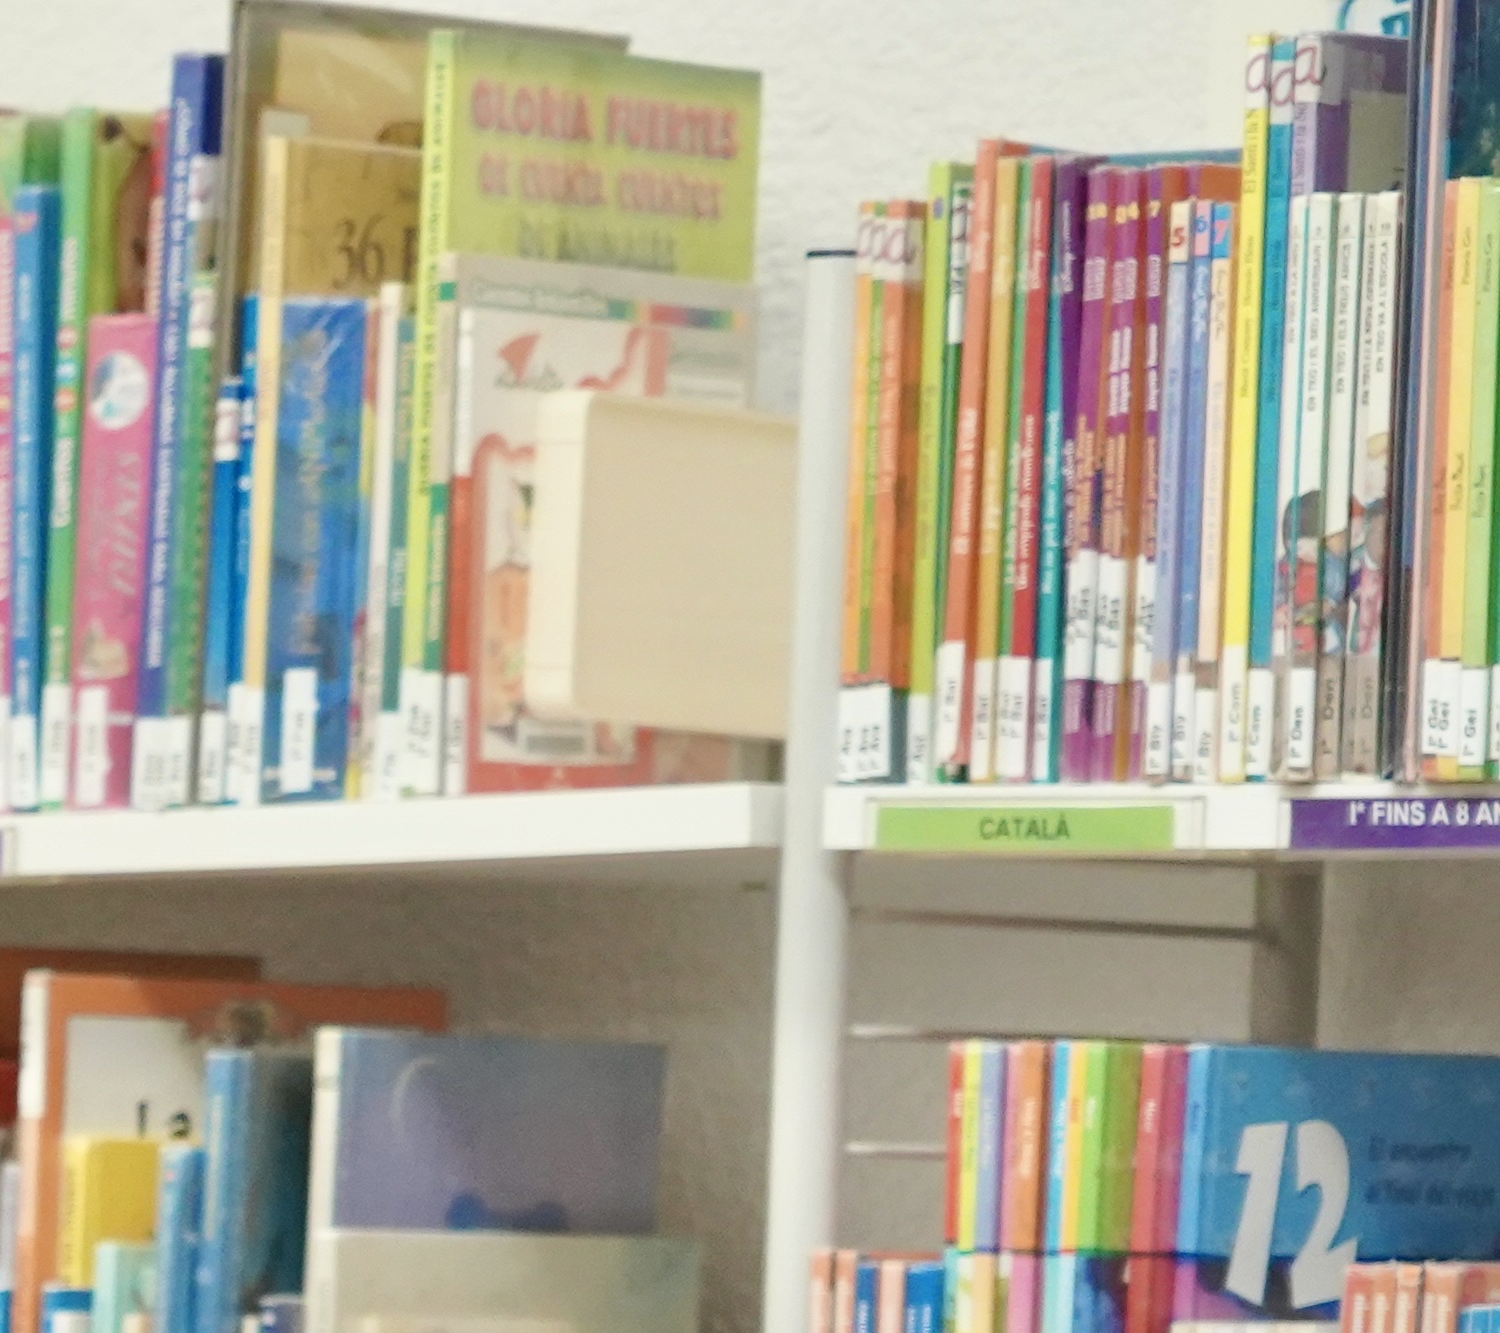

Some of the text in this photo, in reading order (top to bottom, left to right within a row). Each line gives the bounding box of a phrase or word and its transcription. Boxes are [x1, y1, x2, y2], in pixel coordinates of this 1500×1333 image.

[334, 218, 385, 283] 36
[978, 812, 1071, 841] CATALÀ
[1371, 800, 1426, 827] FINS
[1430, 800, 1450, 826] A
[1455, 800, 1470, 826] 8
[1225, 1119, 1359, 1311] 12
